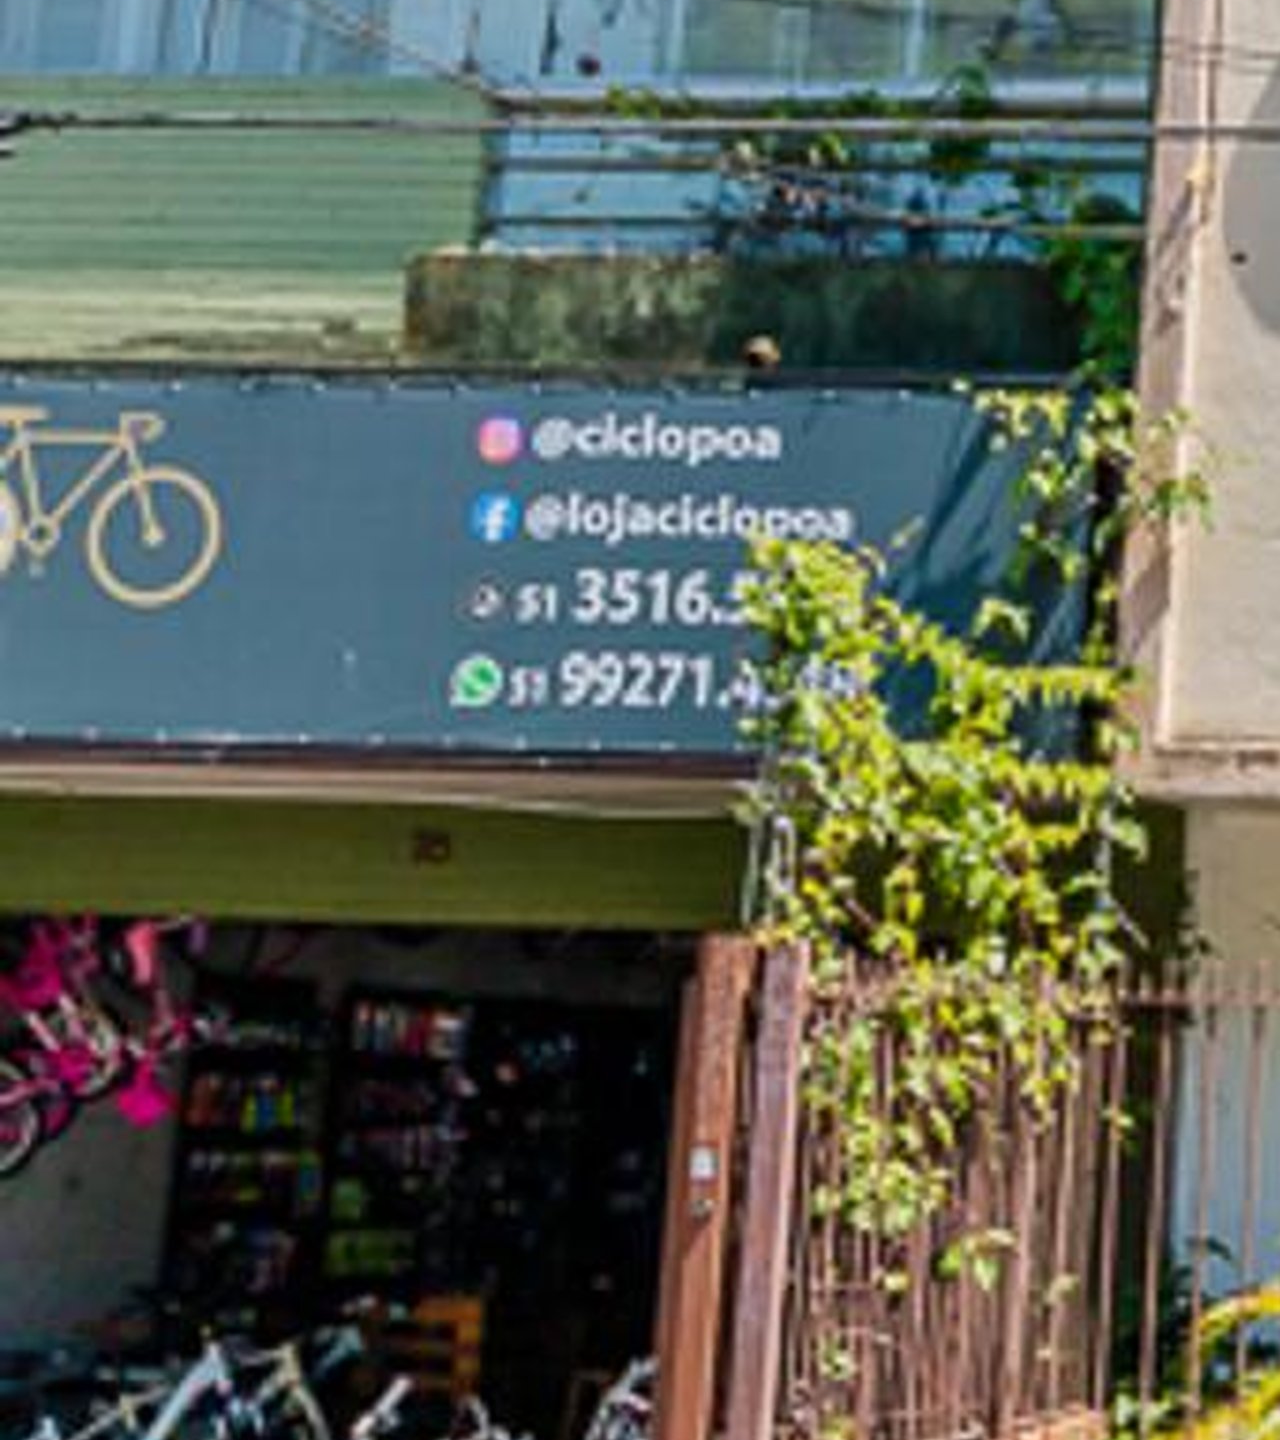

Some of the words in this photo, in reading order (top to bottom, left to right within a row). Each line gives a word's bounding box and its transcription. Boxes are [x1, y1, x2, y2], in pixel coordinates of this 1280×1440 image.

[532, 413, 782, 467] @ciclopoa
[523, 491, 855, 546] @lojaciclopoa
[516, 583, 560, 622] 51
[507, 665, 550, 707] 51
